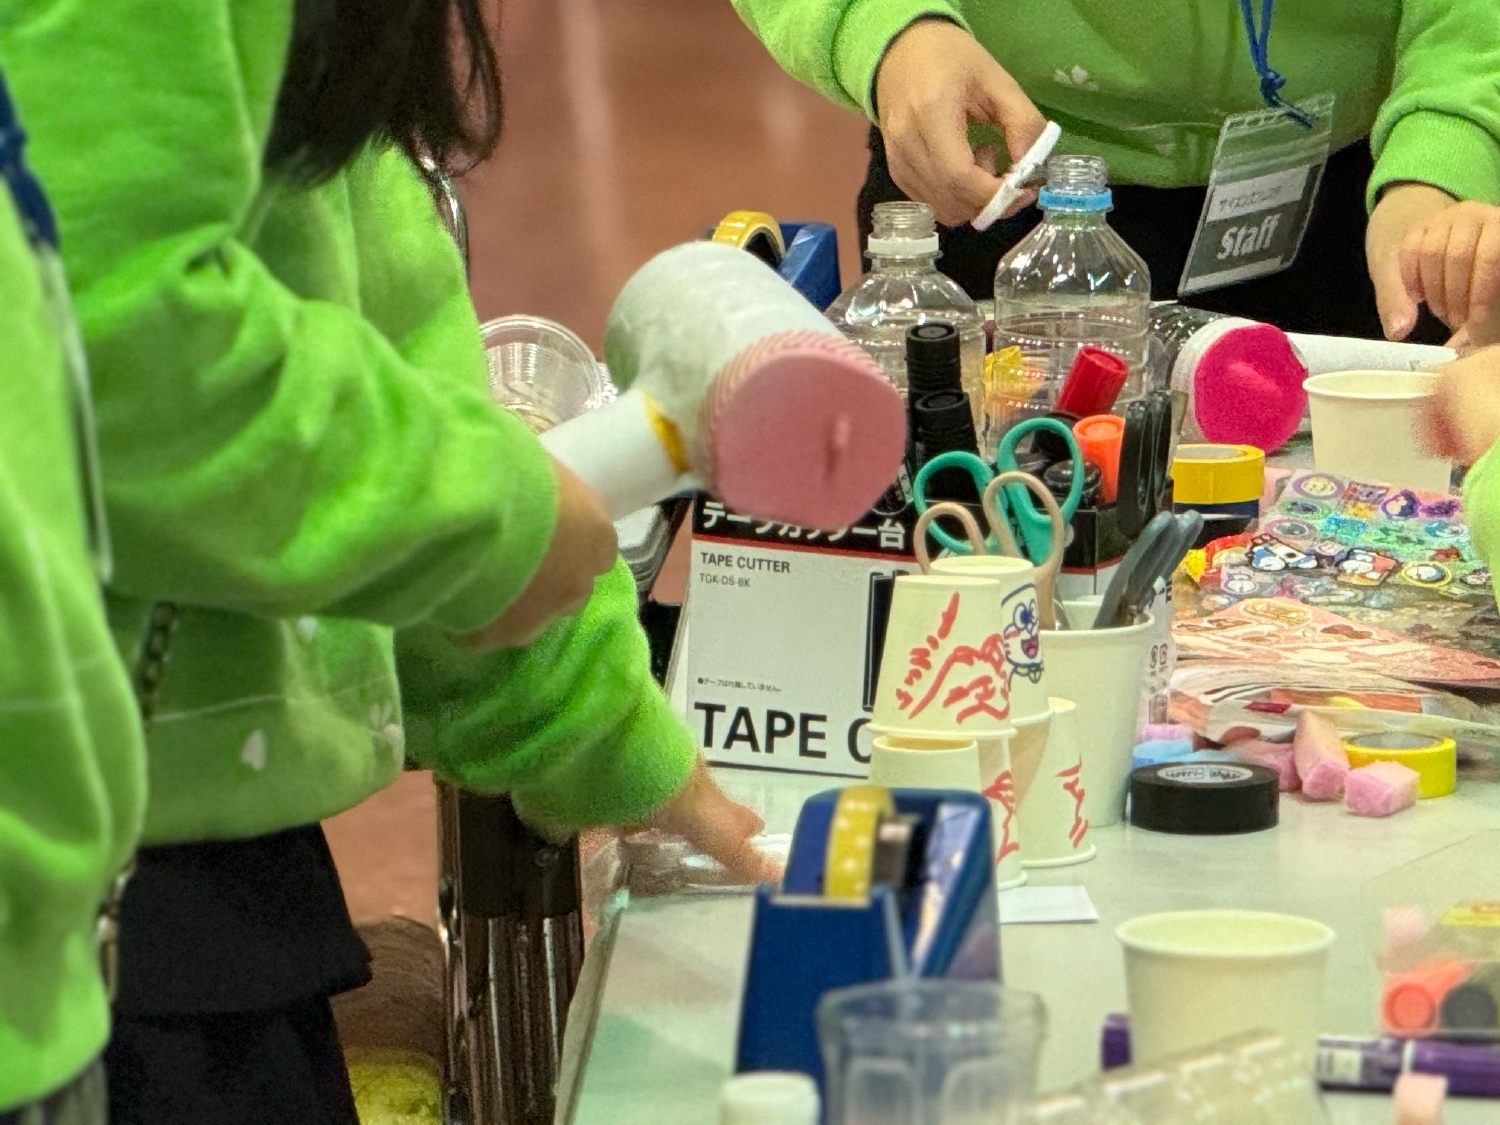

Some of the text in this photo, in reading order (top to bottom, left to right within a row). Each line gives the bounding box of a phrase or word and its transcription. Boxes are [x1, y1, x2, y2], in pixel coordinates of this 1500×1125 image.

[1217, 213, 1282, 259] Staff
[701, 552, 791, 573] TAPE CUTTER
[694, 701, 828, 759] TAPE
